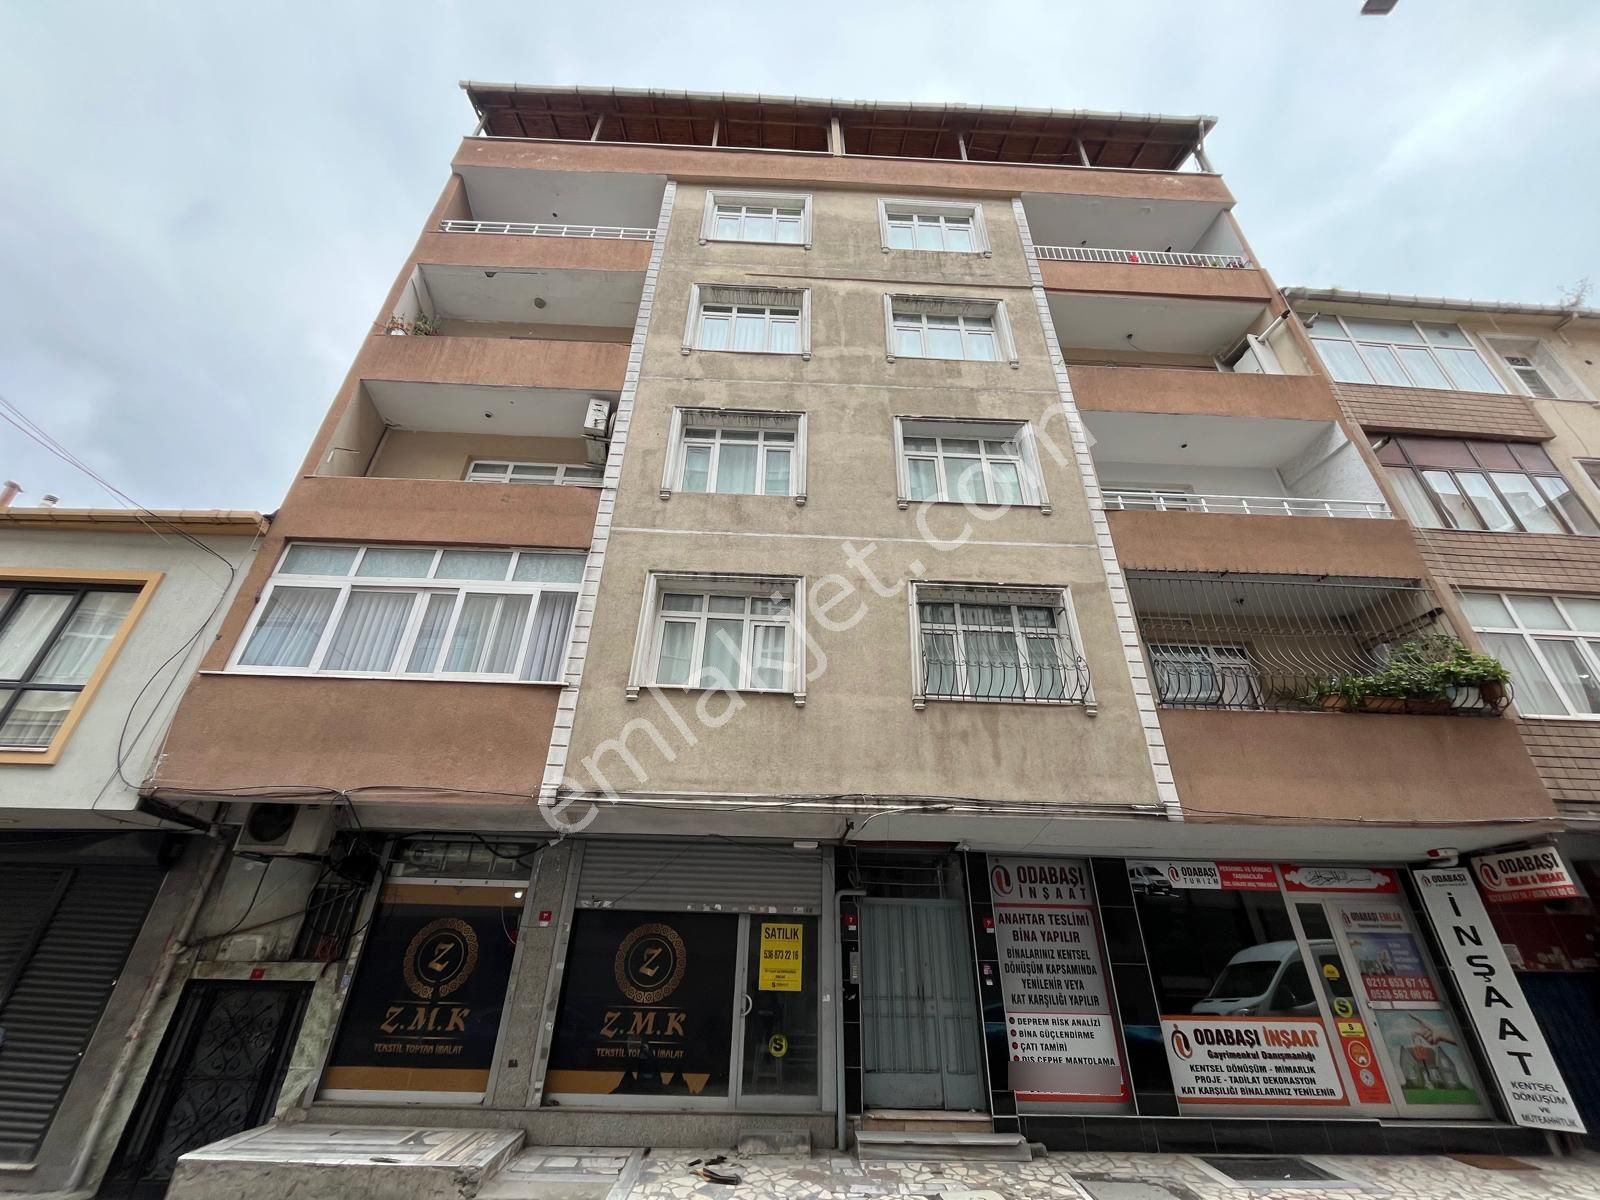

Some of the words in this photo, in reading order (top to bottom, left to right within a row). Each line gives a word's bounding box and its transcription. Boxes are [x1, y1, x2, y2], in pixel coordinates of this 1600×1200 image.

[1497, 852, 1560, 874] ODABAŞI
[1017, 865, 1085, 887] ODABAŞI
[1181, 866, 1217, 878] ODABAŞI
[1019, 884, 1086, 900] İNŞAAT
[998, 913, 1045, 925] ANAHTAR
[1048, 912, 1089, 926] TESLİMİ
[764, 927, 799, 940] SATILIK
[1013, 928, 1037, 942] BİNA
[1041, 930, 1080, 943] YAPILIR
[428, 942, 455, 972] Z
[1007, 946, 1055, 959] BİNALARINIZ
[1057, 949, 1090, 960] KENTSEL
[639, 947, 662, 977] Z
[1005, 962, 1044, 976] DÖNÜŞÜM
[1046, 964, 1097, 975] KAPSAMINDA
[1022, 977, 1062, 990] YENİLENİR
[1064, 979, 1085, 990] VEYA
[1447, 892, 1533, 1076] İNŞAAT
[1011, 994, 1025, 1005] KAT
[1028, 993, 1067, 1008] KARŞILIĞI
[1069, 995, 1100, 1006] YAPILIR
[380, 1006, 471, 1034] Z.M.K
[600, 1011, 687, 1039] Z.M.K
[1017, 1017, 1049, 1027] DEPREM
[1052, 1017, 1070, 1026] RİSK
[1072, 1017, 1101, 1027] ANALİZİ
[1019, 1029, 1037, 1038] BİNA
[1040, 1029, 1095, 1040] GÜÇLENDİRME
[1193, 1028, 1261, 1049] ODABAŞI
[1262, 1025, 1320, 1049] İNŞAAT
[1021, 1042, 1038, 1052] ÇATI
[1040, 1042, 1068, 1052] TAMİRİ
[1207, 1050, 1259, 1061] Gayrimenkul
[1261, 1050, 1316, 1061] Danışmanlığı
[1189, 1064, 1224, 1073] KENTSEL
[1226, 1063, 1267, 1075] DÖNÜŞÜM
[1275, 1064, 1316, 1074] MİMARLIK
[1195, 1075, 1222, 1084] PROJE
[1230, 1075, 1261, 1085] TADİLAT
[1263, 1075, 1316, 1085] DEKORASYON
[1511, 1081, 1559, 1093] KENTSEL
[1181, 1086, 1196, 1095] KAT
[1199, 1085, 1238, 1097] KARŞILIĞI
[1240, 1086, 1293, 1096] BİNALARINIZ
[1293, 1086, 1336, 1097] YENİLENİR
